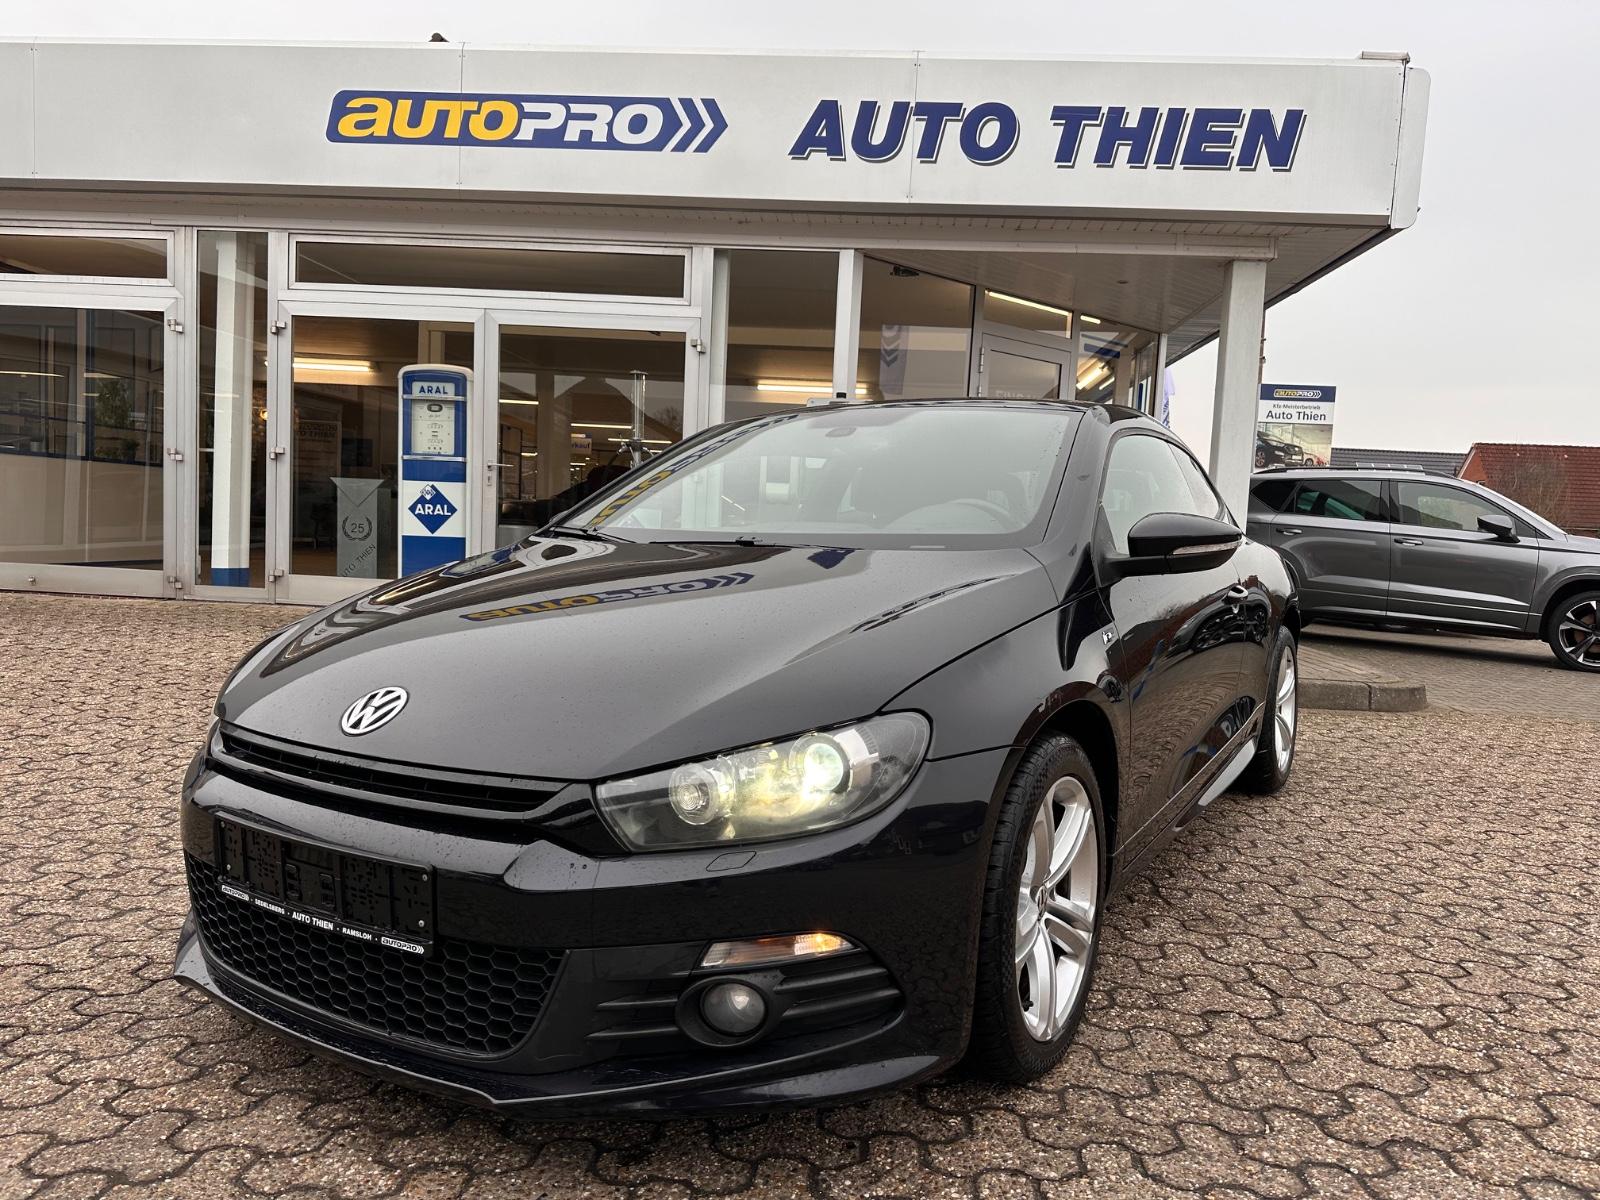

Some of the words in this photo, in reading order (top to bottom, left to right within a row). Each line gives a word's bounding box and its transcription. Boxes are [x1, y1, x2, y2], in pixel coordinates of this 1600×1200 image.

[788, 99, 1020, 166] AUTO
[1050, 105, 1307, 171] THIEN
[419, 385, 448, 395] ARAL
[1266, 410, 1293, 420] Auto
[1296, 411, 1327, 421] Thien
[414, 504, 451, 515] ARAL
[351, 522, 365, 533] 25
[292, 911, 311, 923] AUTO
[312, 917, 334, 930] THIEN
[342, 927, 372, 941] RAMSLOH
